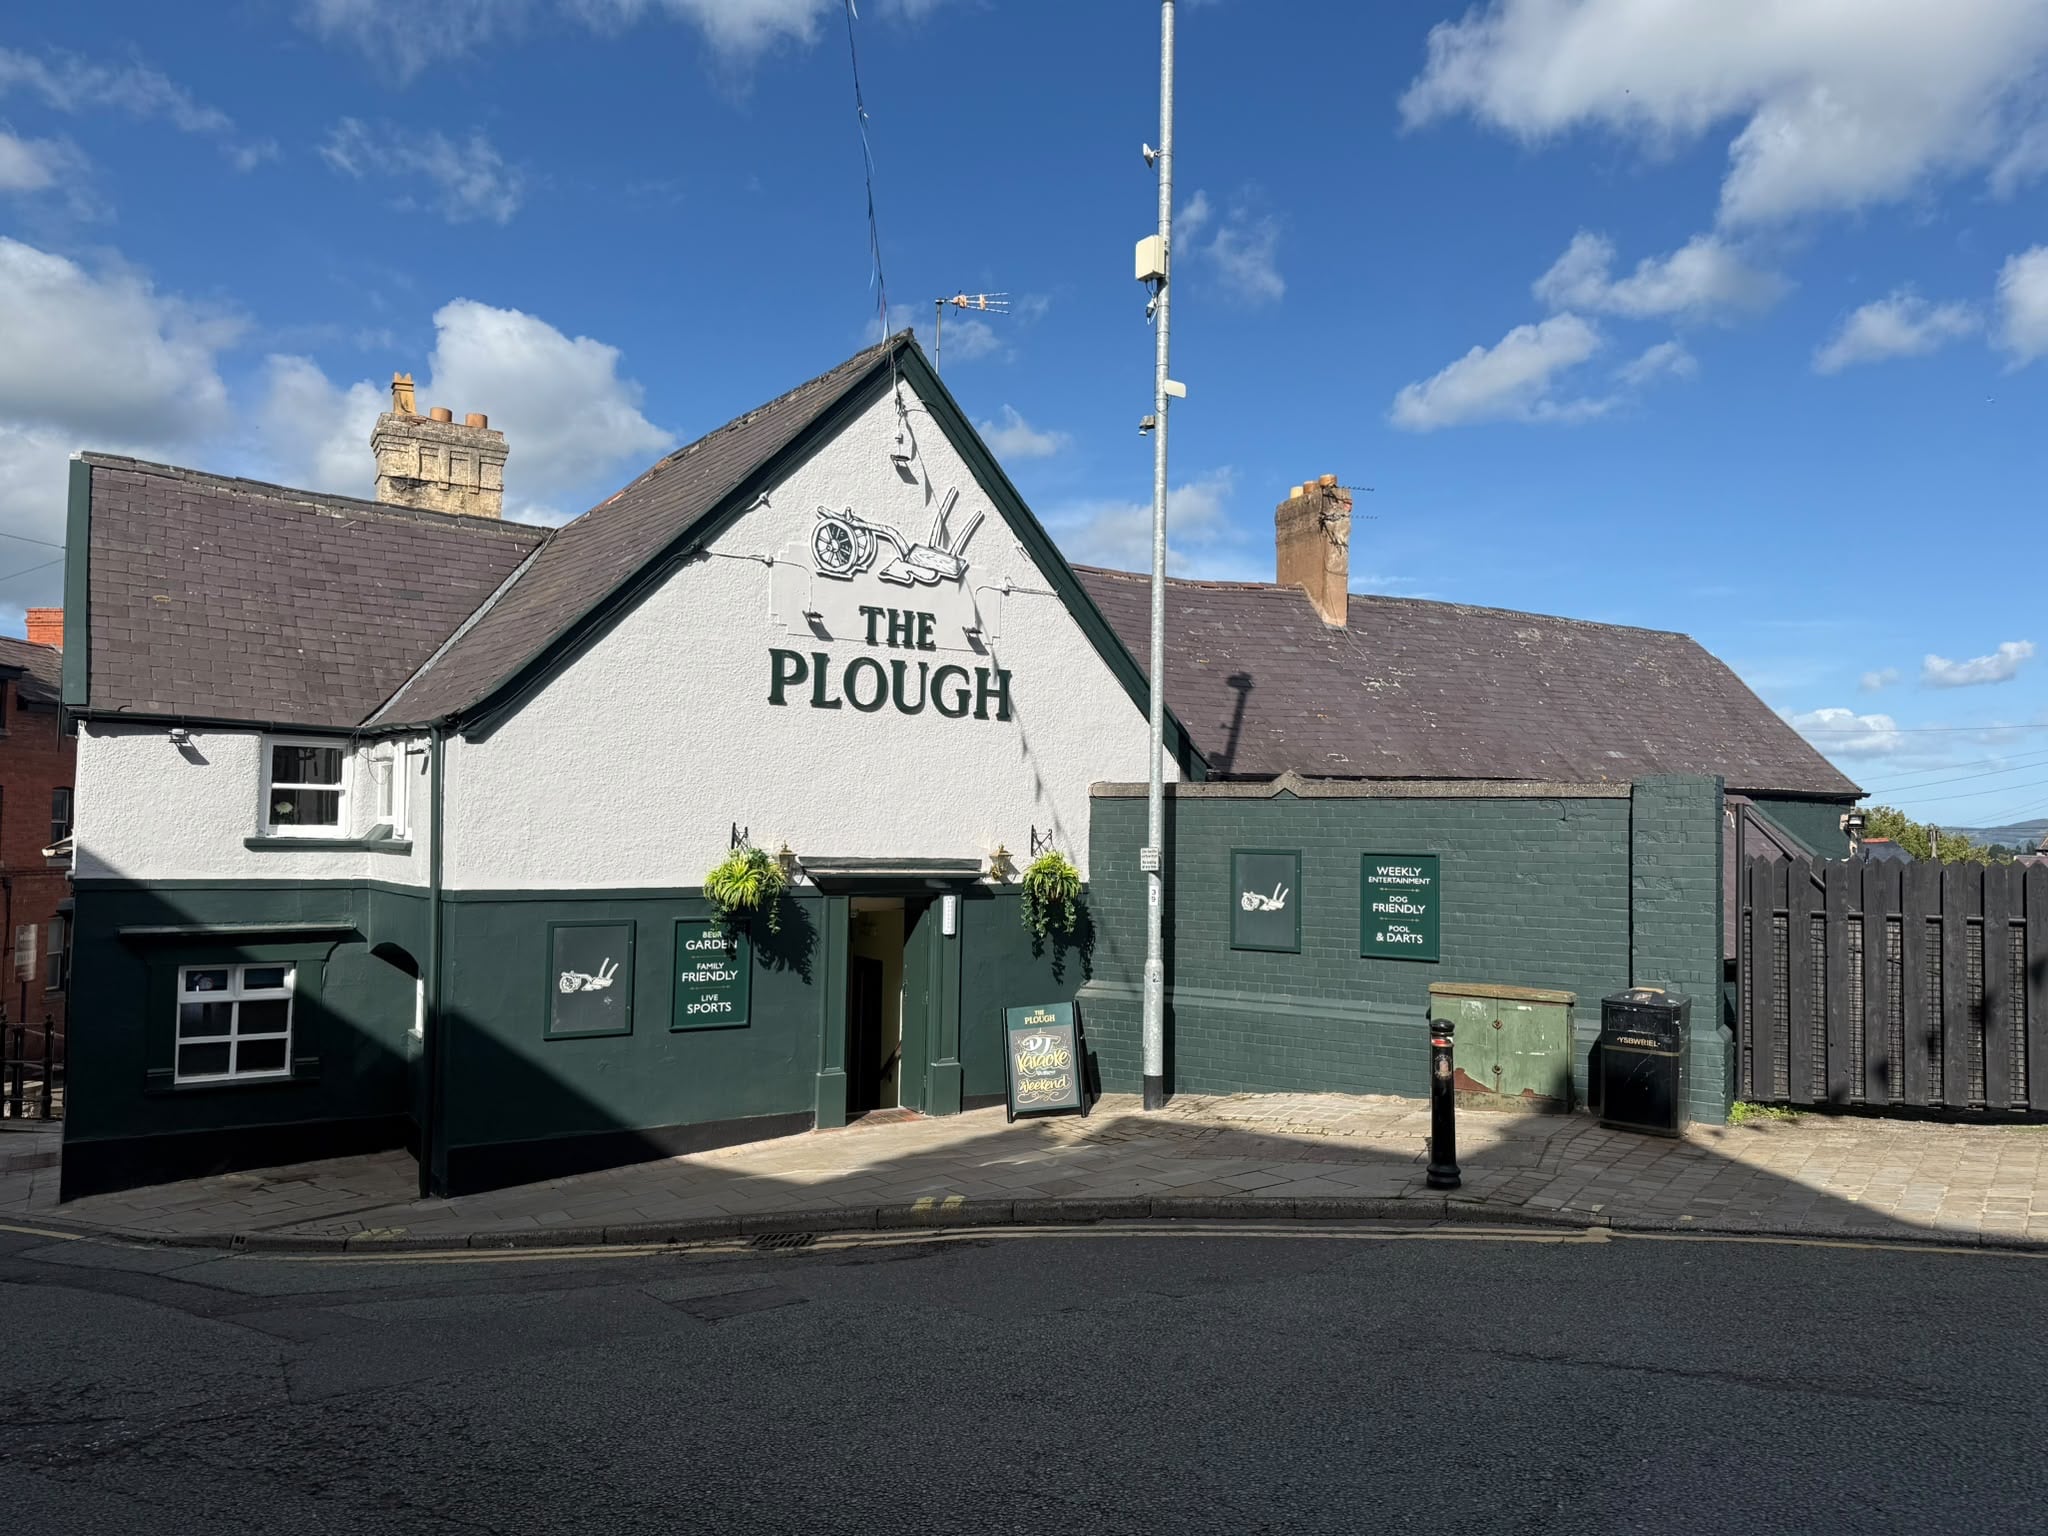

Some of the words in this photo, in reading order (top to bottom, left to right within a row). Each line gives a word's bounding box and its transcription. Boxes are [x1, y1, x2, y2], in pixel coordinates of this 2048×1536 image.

[859, 605, 936, 651] THE
[768, 648, 1012, 722] PLOUGH
[1376, 866, 1422, 876] WEEKLY
[1368, 876, 1431, 885] ENTERTAINMENT
[1372, 903, 1426, 914] FRIENDLY
[1388, 925, 1410, 933] POOL
[1376, 932, 1384, 942] &
[1386, 933, 1423, 944] DARTS
[685, 939, 738, 951] GARDEN
[696, 962, 724, 970] FAMILY
[681, 970, 739, 982] FRIENDLY
[701, 994, 719, 1002] LIVE
[687, 1002, 732, 1014] SPORTS
[1024, 1014, 1056, 1025] PLOUGH
[1016, 1049, 1069, 1073] Karaoke
[1019, 1074, 1067, 1093] Weekend
